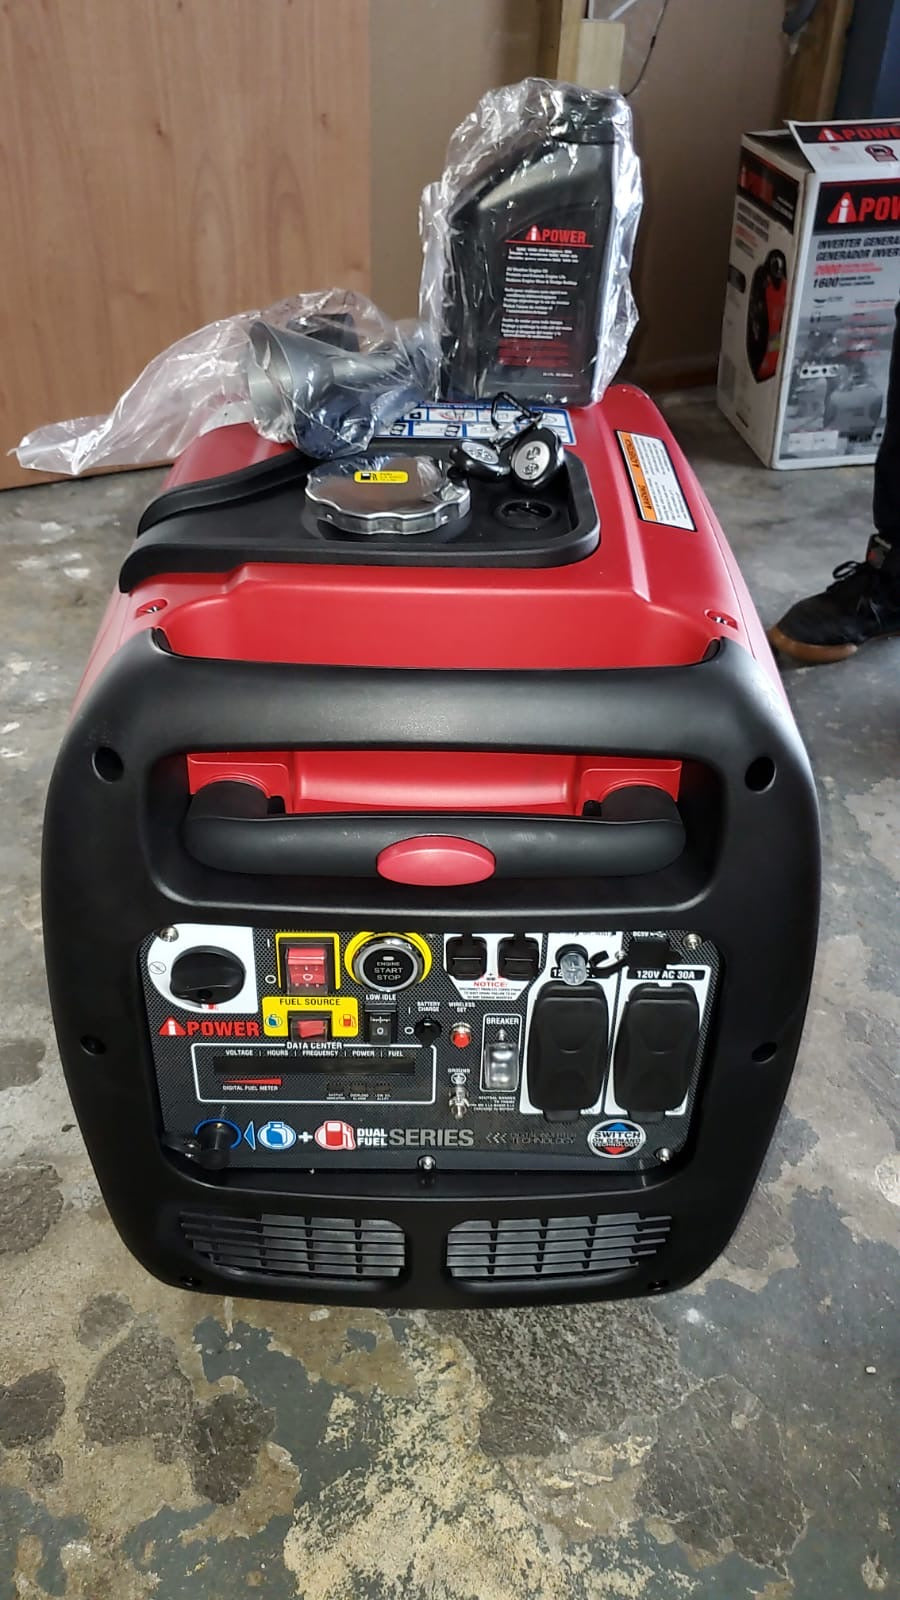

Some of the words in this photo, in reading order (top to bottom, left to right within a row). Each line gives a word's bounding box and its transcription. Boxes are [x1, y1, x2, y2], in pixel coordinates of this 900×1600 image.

[817, 239, 862, 249] INVERTER
[816, 249, 871, 261] GENERADOR
[637, 970, 660, 979] 120V
[662, 970, 676, 979] AC
[677, 970, 695, 979] 30A
[280, 998, 302, 1006] FUEL
[305, 998, 341, 1006] SOURCE
[486, 1017, 519, 1025] BREAKER
[357, 1128, 387, 1137] DUAL
[389, 1128, 474, 1146] SERIES
[357, 1138, 387, 1146] FUEL
